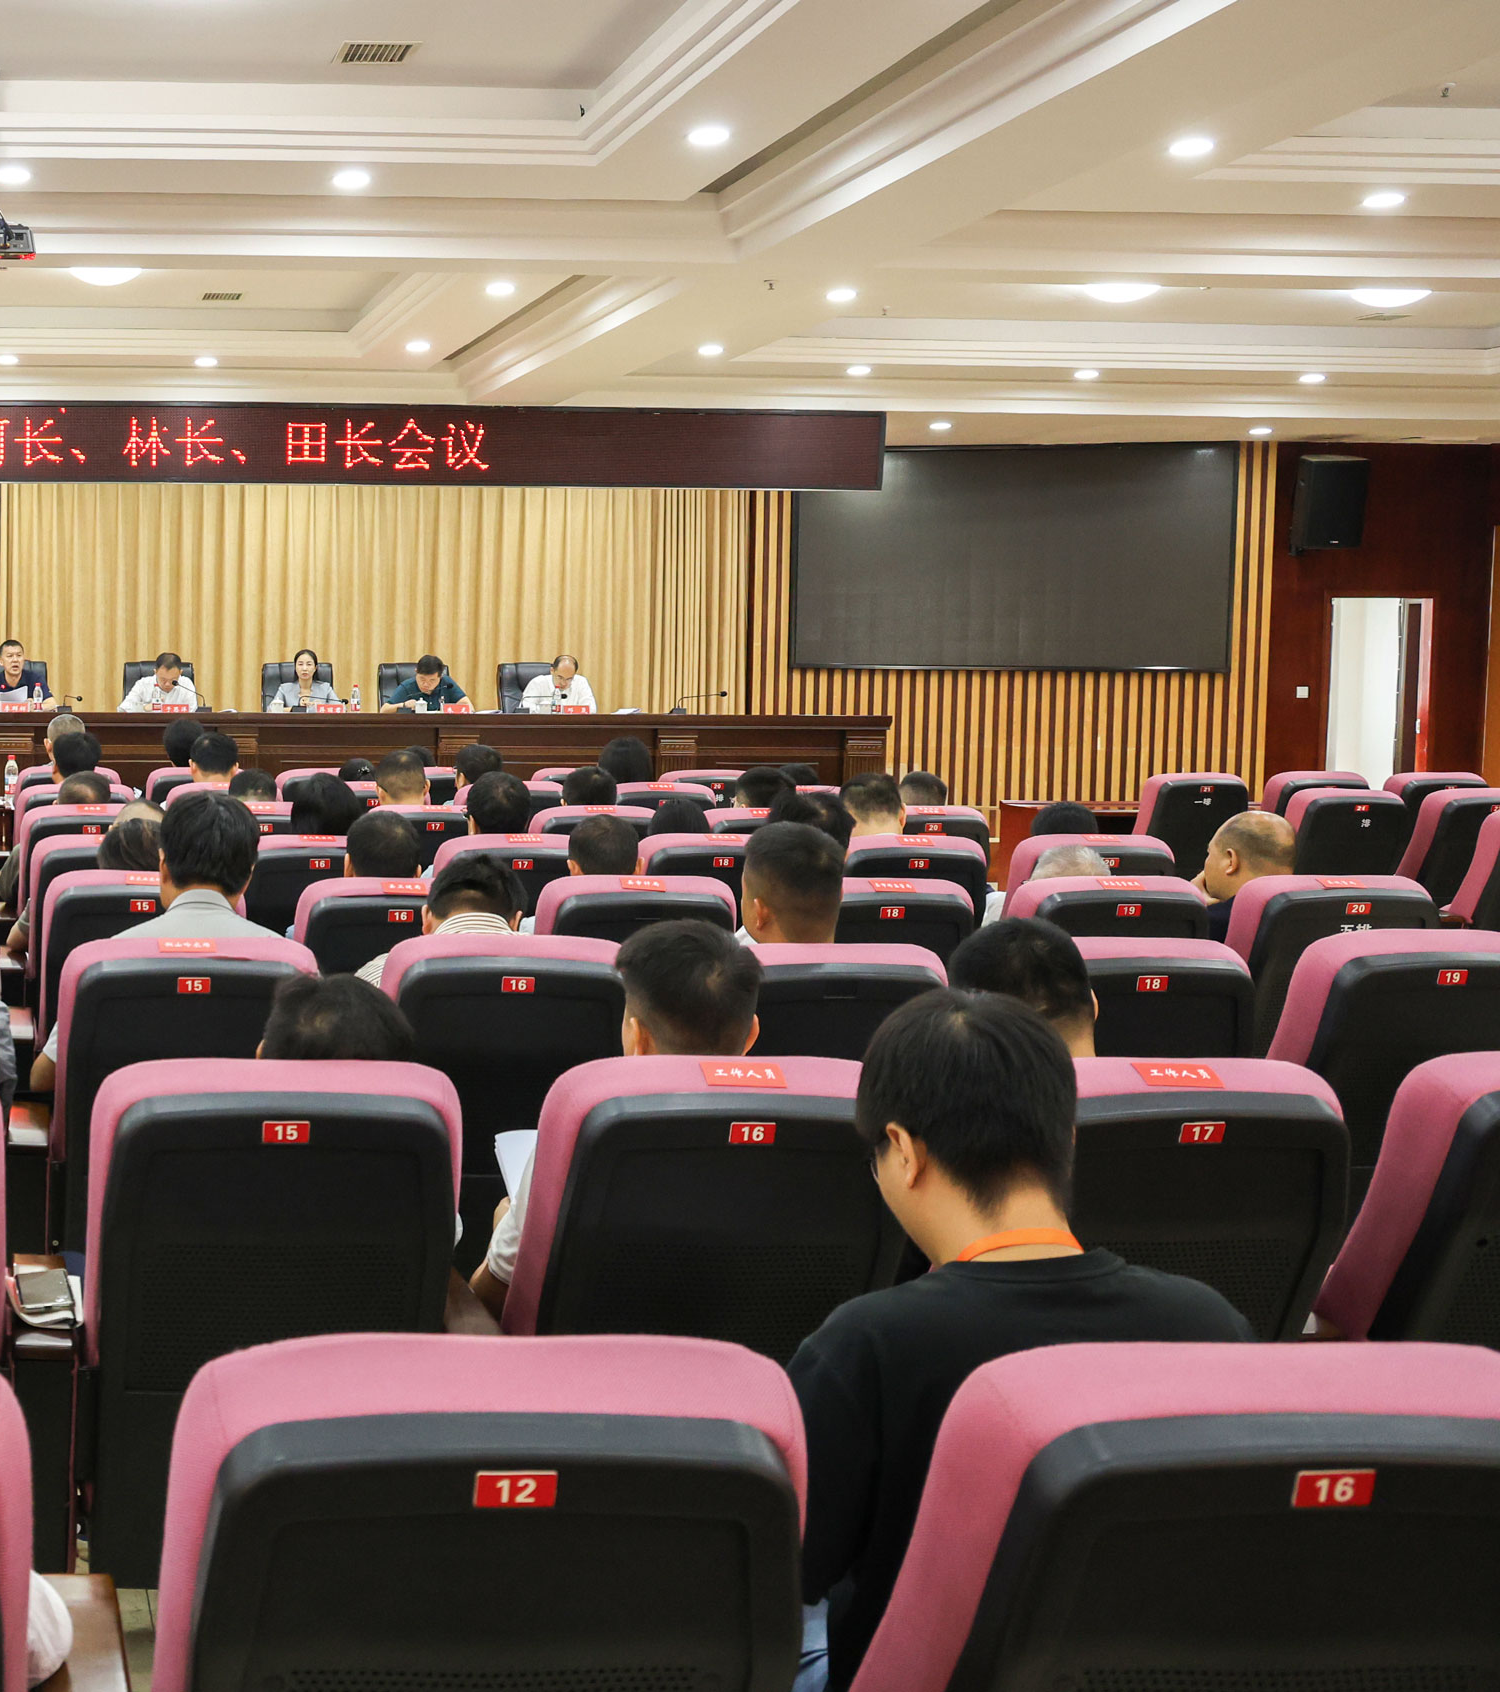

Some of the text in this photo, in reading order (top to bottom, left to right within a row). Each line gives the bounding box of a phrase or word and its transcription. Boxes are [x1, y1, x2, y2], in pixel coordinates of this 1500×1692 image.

[137, 902, 149, 910] 15
[395, 912, 407, 920] 16
[1446, 972, 1460, 983] 19
[186, 980, 202, 991] 15
[511, 980, 526, 990] 16
[1144, 978, 1160, 989] 18
[715, 1068, 776, 1079] 工作人员
[1150, 1068, 1211, 1079] 工作人员
[275, 1126, 298, 1140] 15
[741, 1126, 764, 1141] 16
[1192, 1126, 1214, 1140] 17
[497, 1479, 536, 1502] 12
[1316, 1477, 1354, 1502] 16
